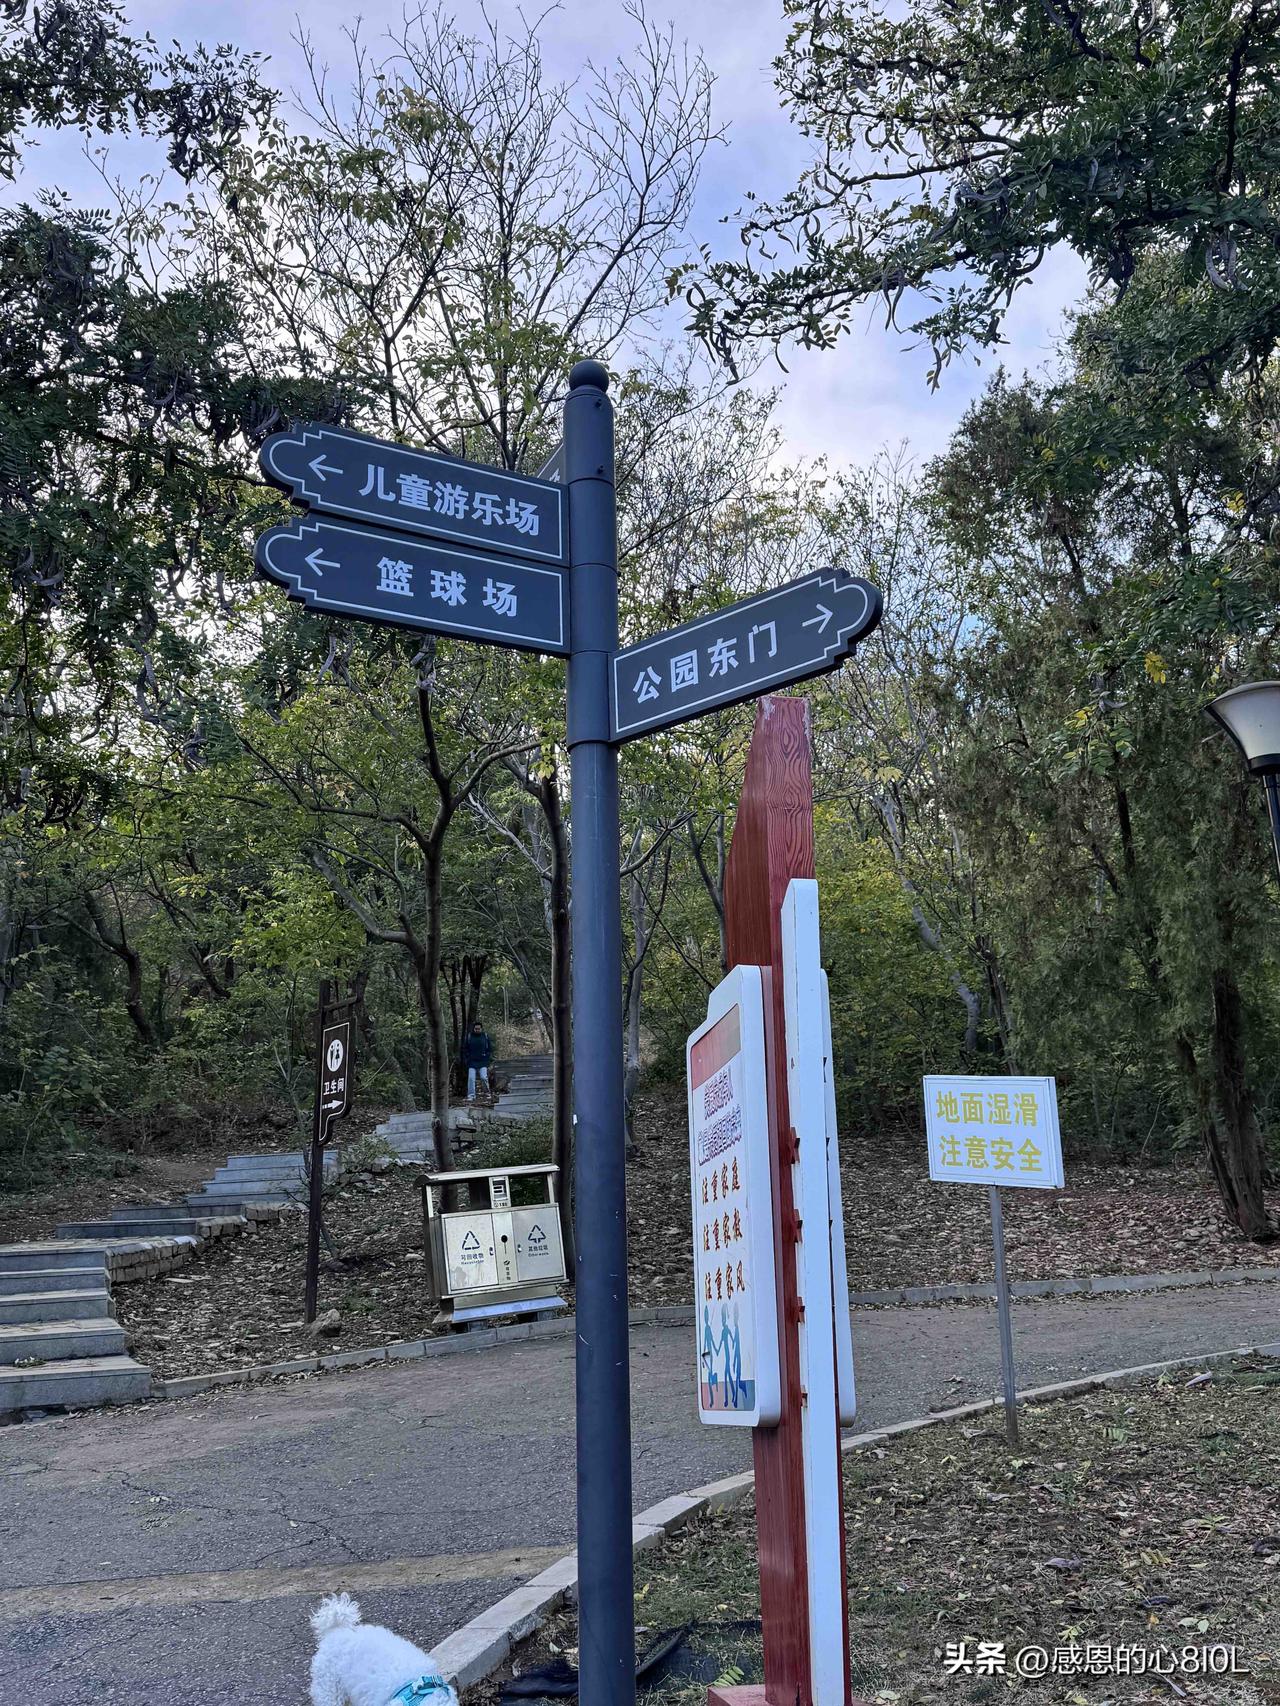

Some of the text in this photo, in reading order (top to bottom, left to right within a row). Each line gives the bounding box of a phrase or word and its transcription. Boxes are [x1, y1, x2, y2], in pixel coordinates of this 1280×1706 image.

[358, 463, 541, 537] 儿童游乐场
[376, 555, 519, 618] 篮球场
[632, 620, 778, 705] 公园东门
[323, 1077, 345, 1096] 卫生间
[936, 1090, 1039, 1127] 地面湿滑
[939, 1135, 1042, 1172] 注意安全
[702, 1156, 741, 1205] 注重家庭
[705, 1260, 745, 1301] 注重家风
